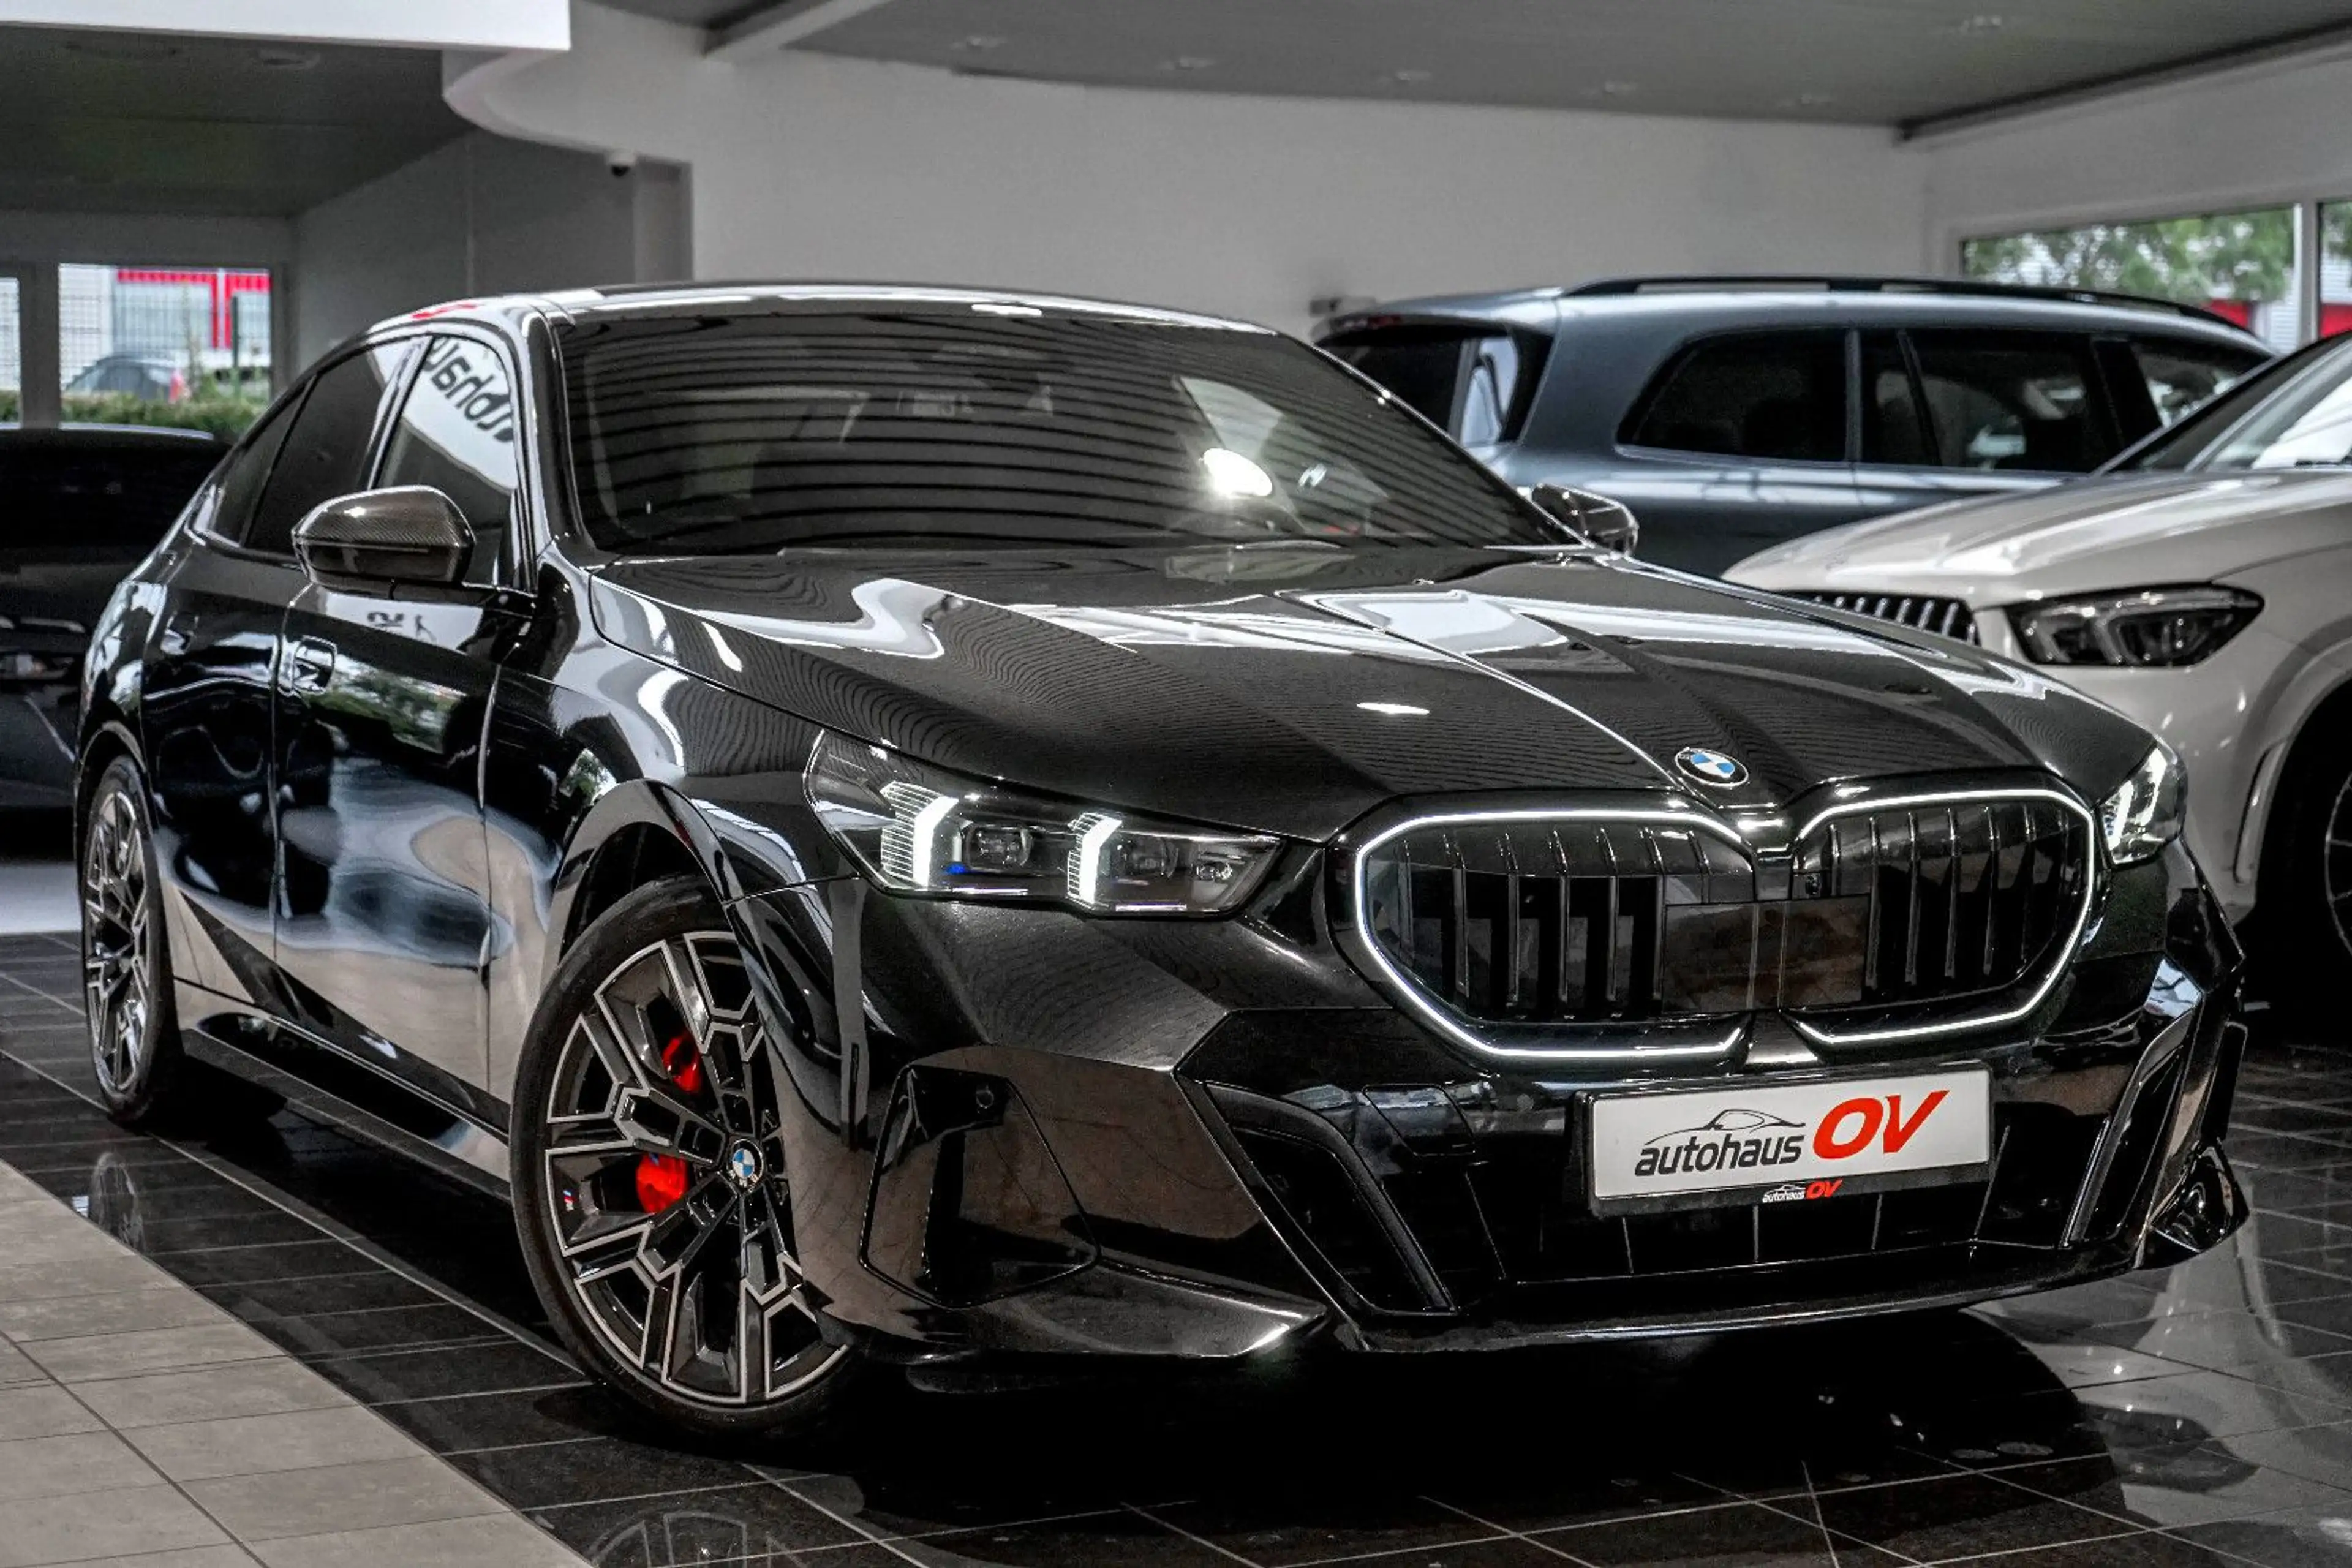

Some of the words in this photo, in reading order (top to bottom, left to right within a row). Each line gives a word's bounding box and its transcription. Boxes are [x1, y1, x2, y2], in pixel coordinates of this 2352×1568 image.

[1634, 1133, 1806, 1177] autohaus
[1813, 1090, 1949, 1159] OV
[1762, 1191, 1806, 1203] autohaus
[1806, 1178, 1843, 1200] OV
